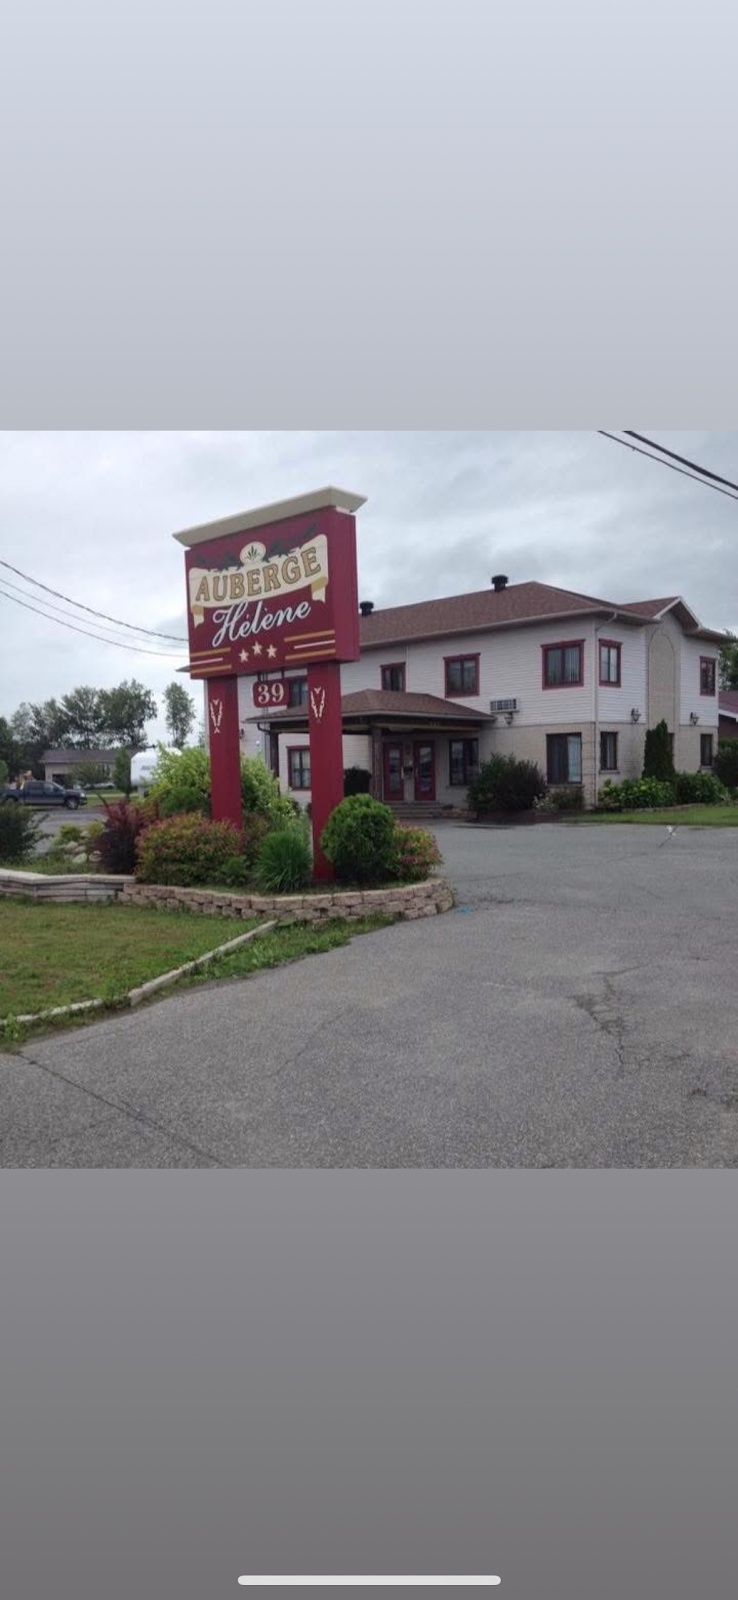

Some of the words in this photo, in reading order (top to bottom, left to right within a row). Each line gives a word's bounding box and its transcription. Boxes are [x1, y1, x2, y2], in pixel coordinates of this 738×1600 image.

[195, 548, 321, 602] AUBERGE
[213, 601, 311, 647] Hélène
[258, 682, 284, 704] 39
